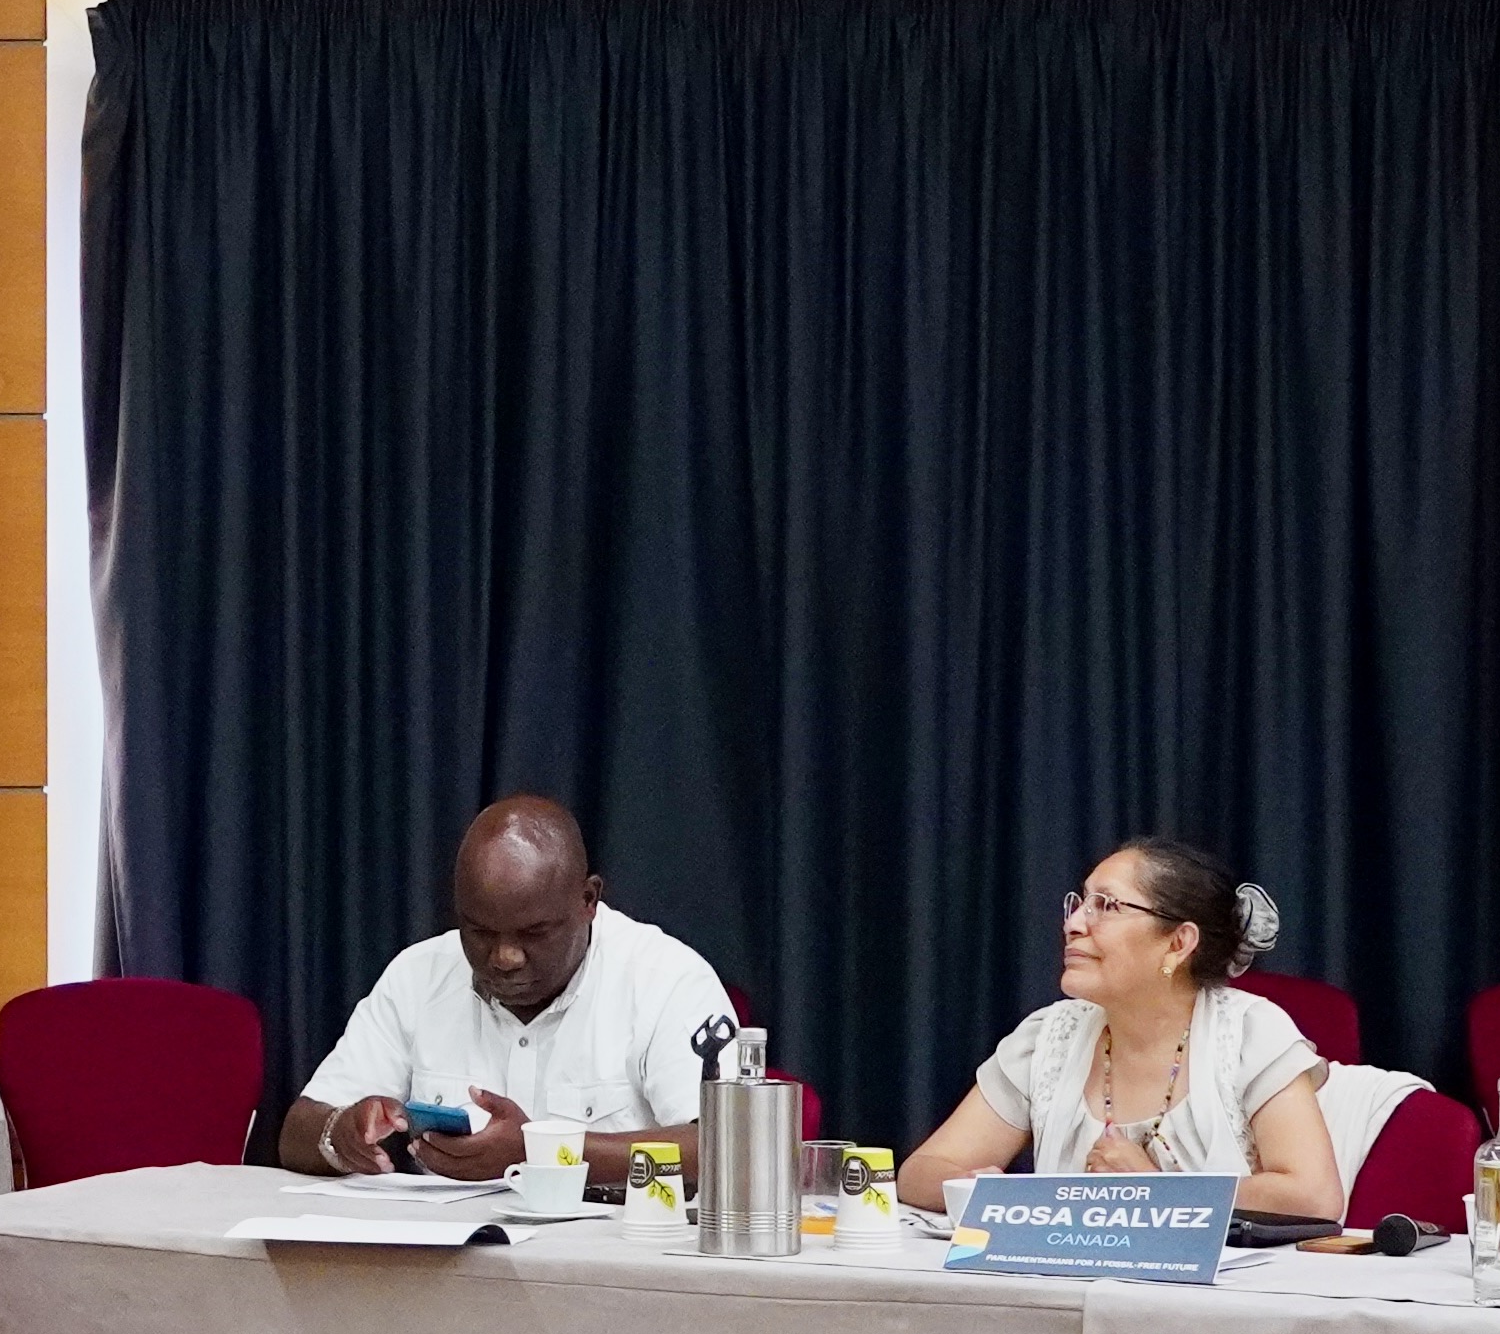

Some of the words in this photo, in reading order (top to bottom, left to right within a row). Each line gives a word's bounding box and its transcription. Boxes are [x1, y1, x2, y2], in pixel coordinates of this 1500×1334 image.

[1055, 1186, 1151, 1201] SENATOR
[980, 1205, 1073, 1227] ROSA
[1081, 1206, 1214, 1229] GALVEZ
[1046, 1232, 1132, 1248] CANADA
[985, 1255, 1074, 1266] PARLIAMENTARIANS
[1075, 1259, 1094, 1267] FOR
[1095, 1259, 1103, 1268] A
[1104, 1260, 1162, 1270] FOSSIL-FREE
[1163, 1262, 1200, 1272] FUTURE
